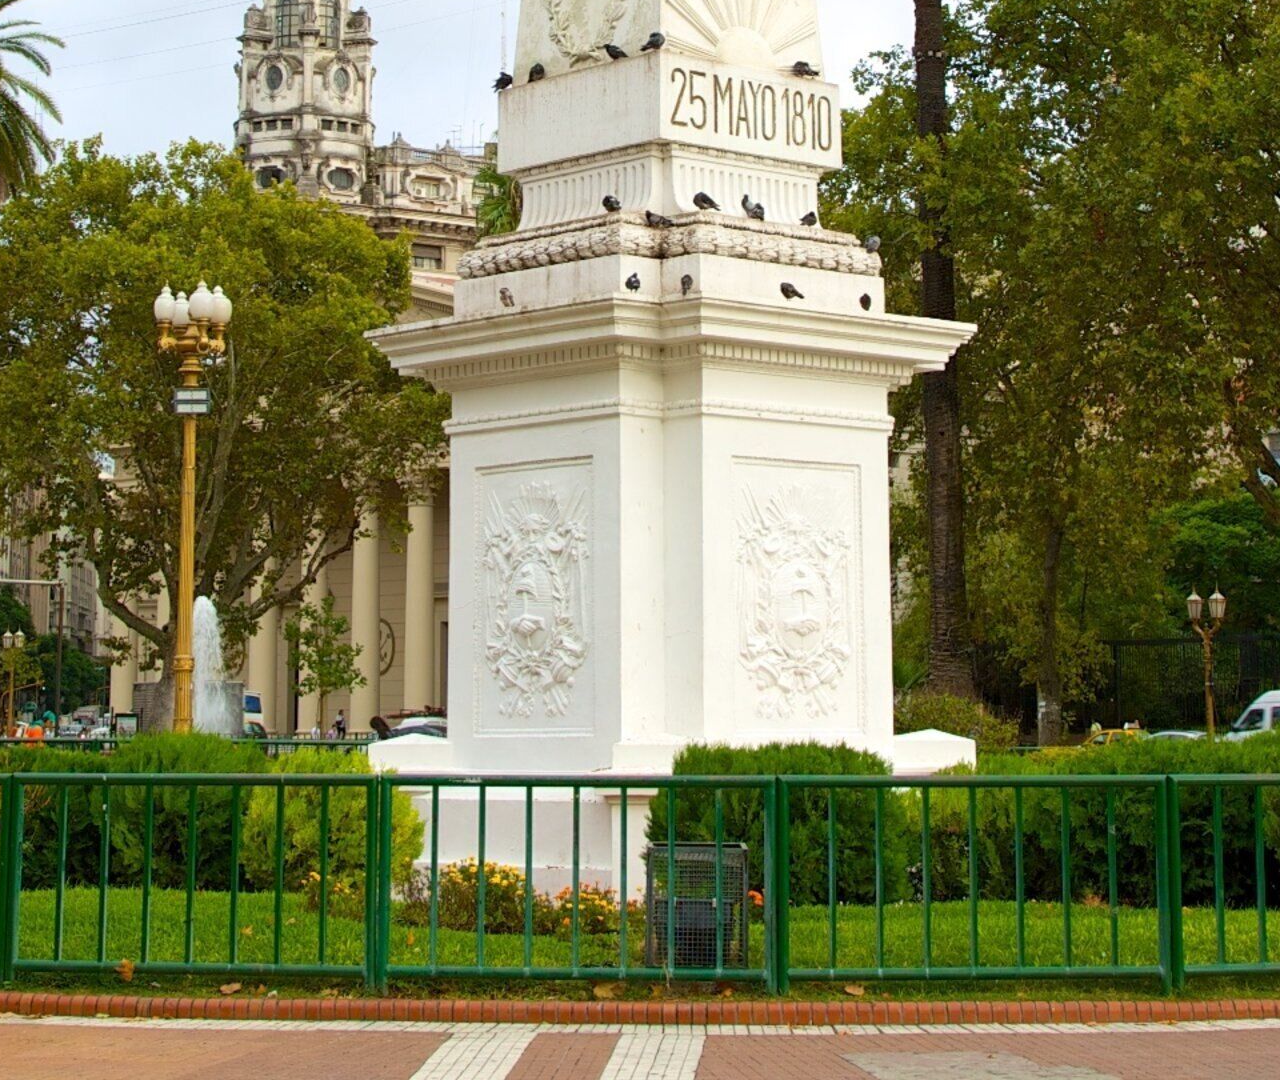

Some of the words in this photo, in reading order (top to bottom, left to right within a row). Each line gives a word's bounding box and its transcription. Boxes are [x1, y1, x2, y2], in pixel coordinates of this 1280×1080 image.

[671, 67, 707, 130] 25
[713, 74, 777, 141] MAYO
[781, 87, 833, 152] 1810
